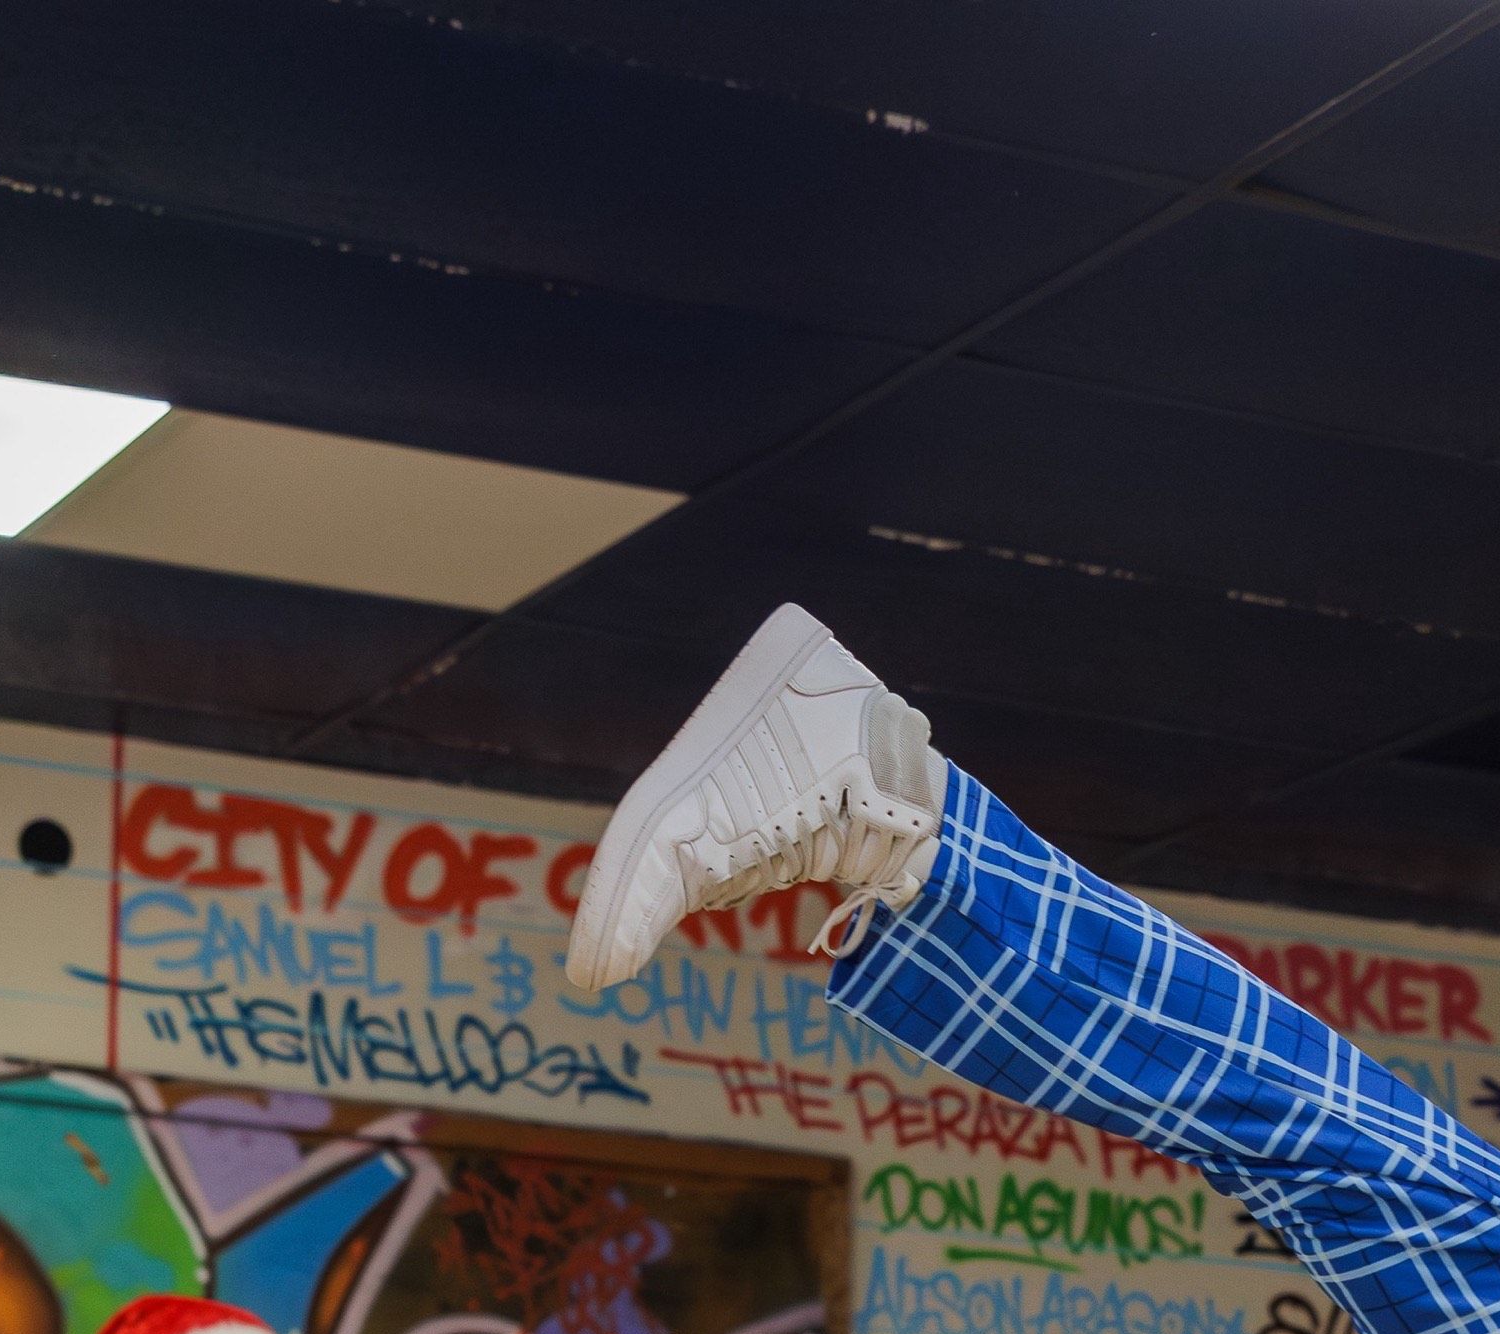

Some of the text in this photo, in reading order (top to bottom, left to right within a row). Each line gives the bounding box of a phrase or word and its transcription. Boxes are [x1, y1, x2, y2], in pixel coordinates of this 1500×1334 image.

[120, 782, 375, 915] CITY
[382, 822, 540, 938] OF
[120, 890, 402, 1000] SAMUEL
[660, 1048, 845, 1133] THE
[864, 1162, 988, 1235] DON
